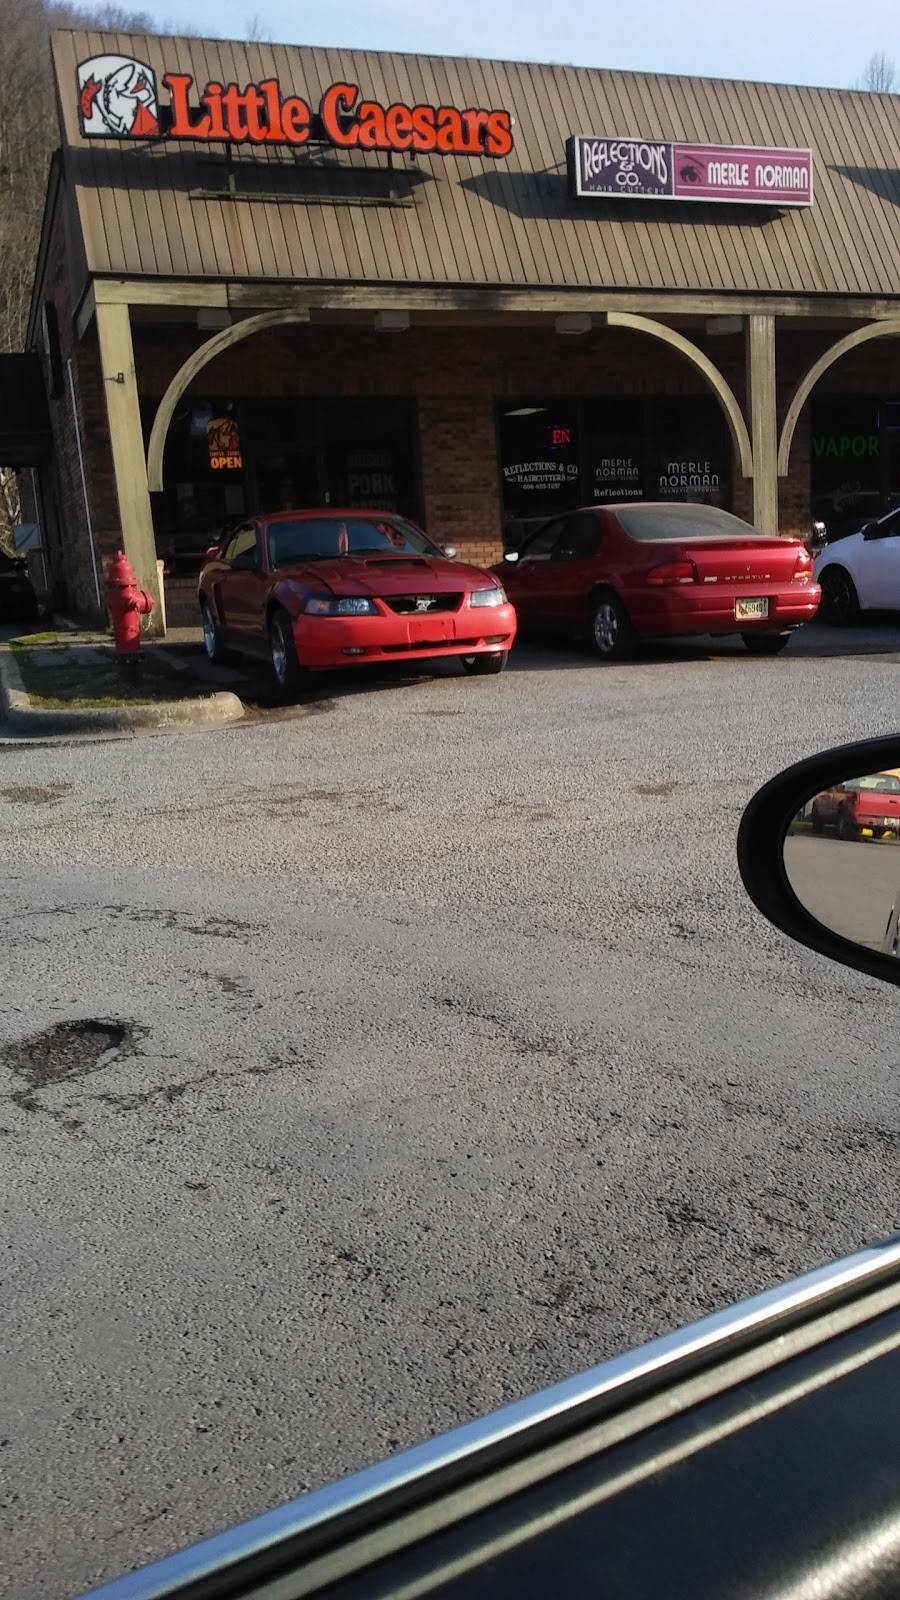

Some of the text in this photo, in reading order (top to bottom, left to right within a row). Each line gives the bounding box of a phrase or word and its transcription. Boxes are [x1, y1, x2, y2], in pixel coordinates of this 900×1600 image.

[162, 73, 513, 156] Little Caesars
[583, 141, 668, 185] REFLECTIONS
[620, 160, 635, 172] &
[615, 172, 642, 186] CO.
[707, 161, 809, 189] MERLE NORMAN
[812, 434, 880, 457] VAPOR
[210, 456, 242, 469] OPEN
[601, 458, 633, 467] MERLE
[667, 461, 711, 474] MERLE
[503, 462, 557, 477] REFLECTIONS
[595, 467, 639, 477] NORMAN
[659, 474, 719, 487] NORMAN
[593, 488, 643, 497] Reflections
